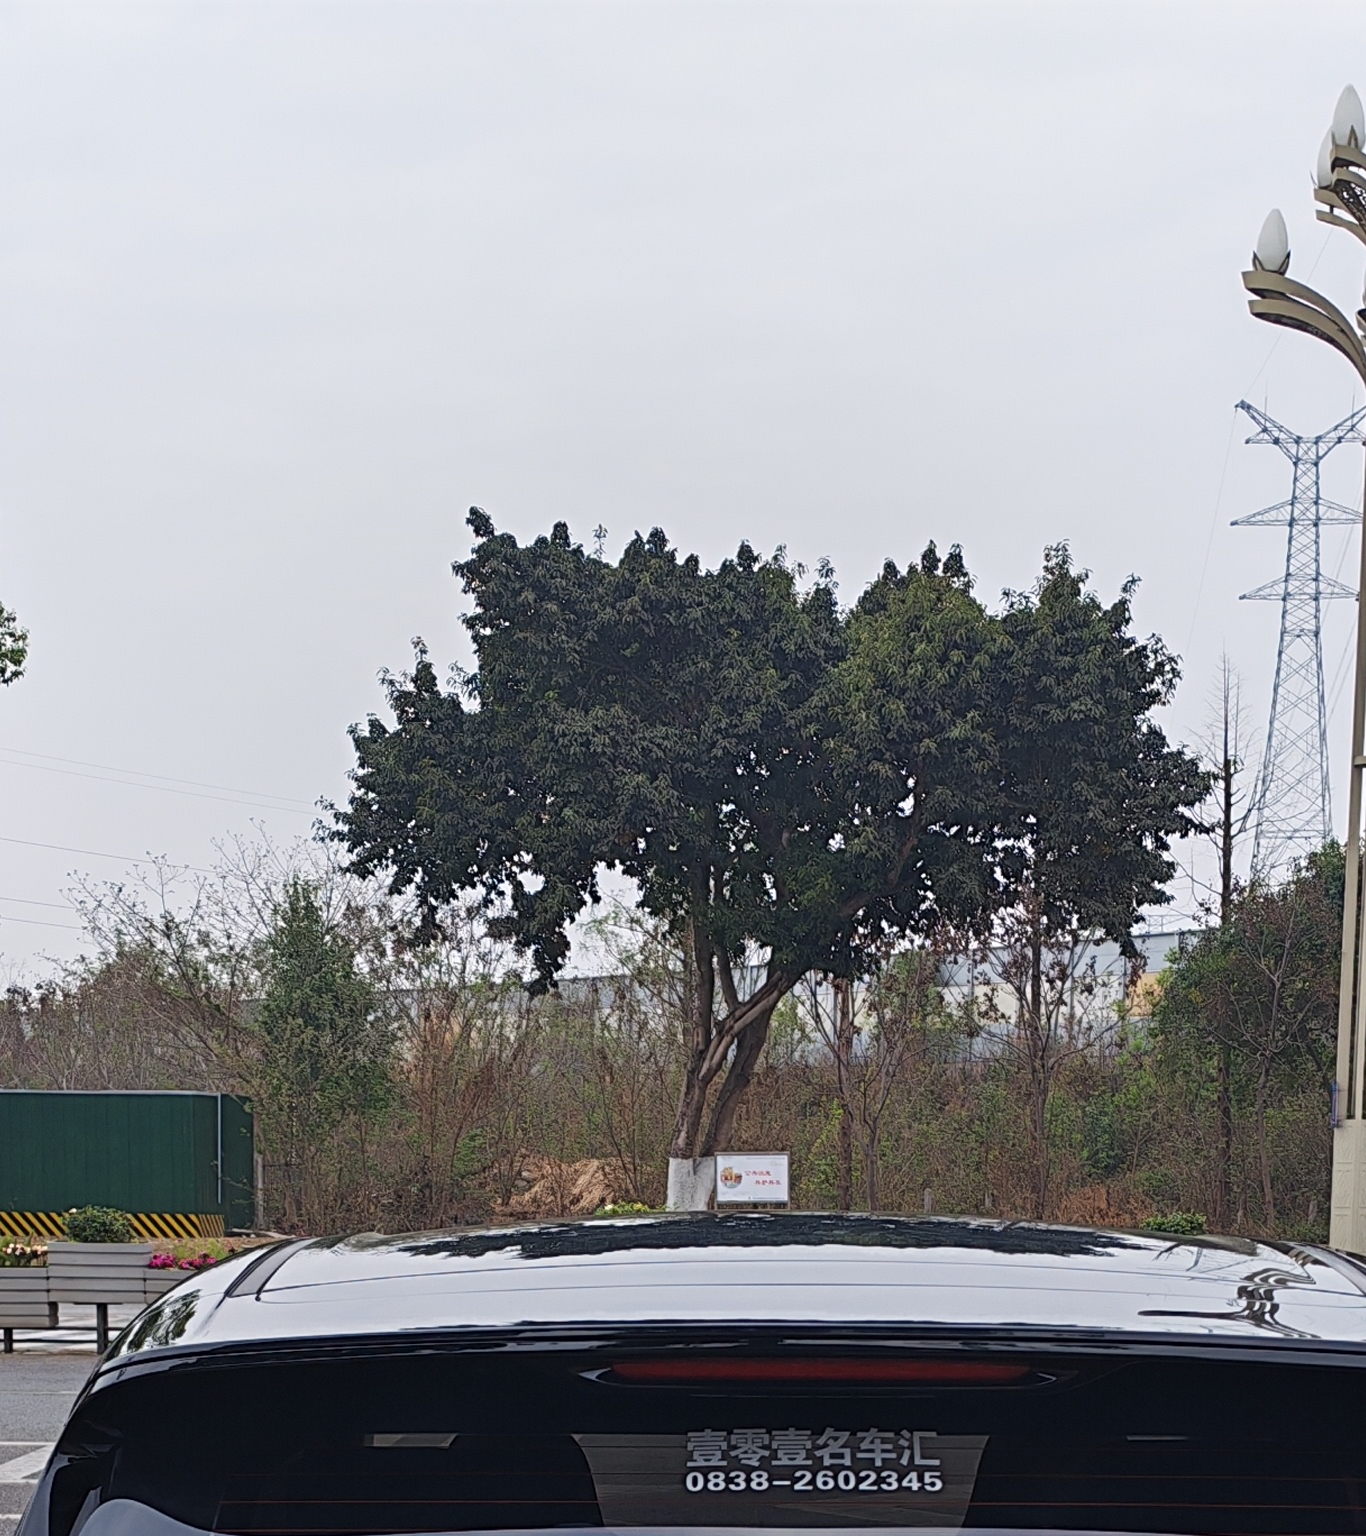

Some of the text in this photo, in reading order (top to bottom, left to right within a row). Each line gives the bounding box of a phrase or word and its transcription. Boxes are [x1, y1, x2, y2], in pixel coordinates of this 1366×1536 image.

[686, 1428, 941, 1467] 壹零壹名车汇
[685, 1470, 943, 1493] 0838-2602345
